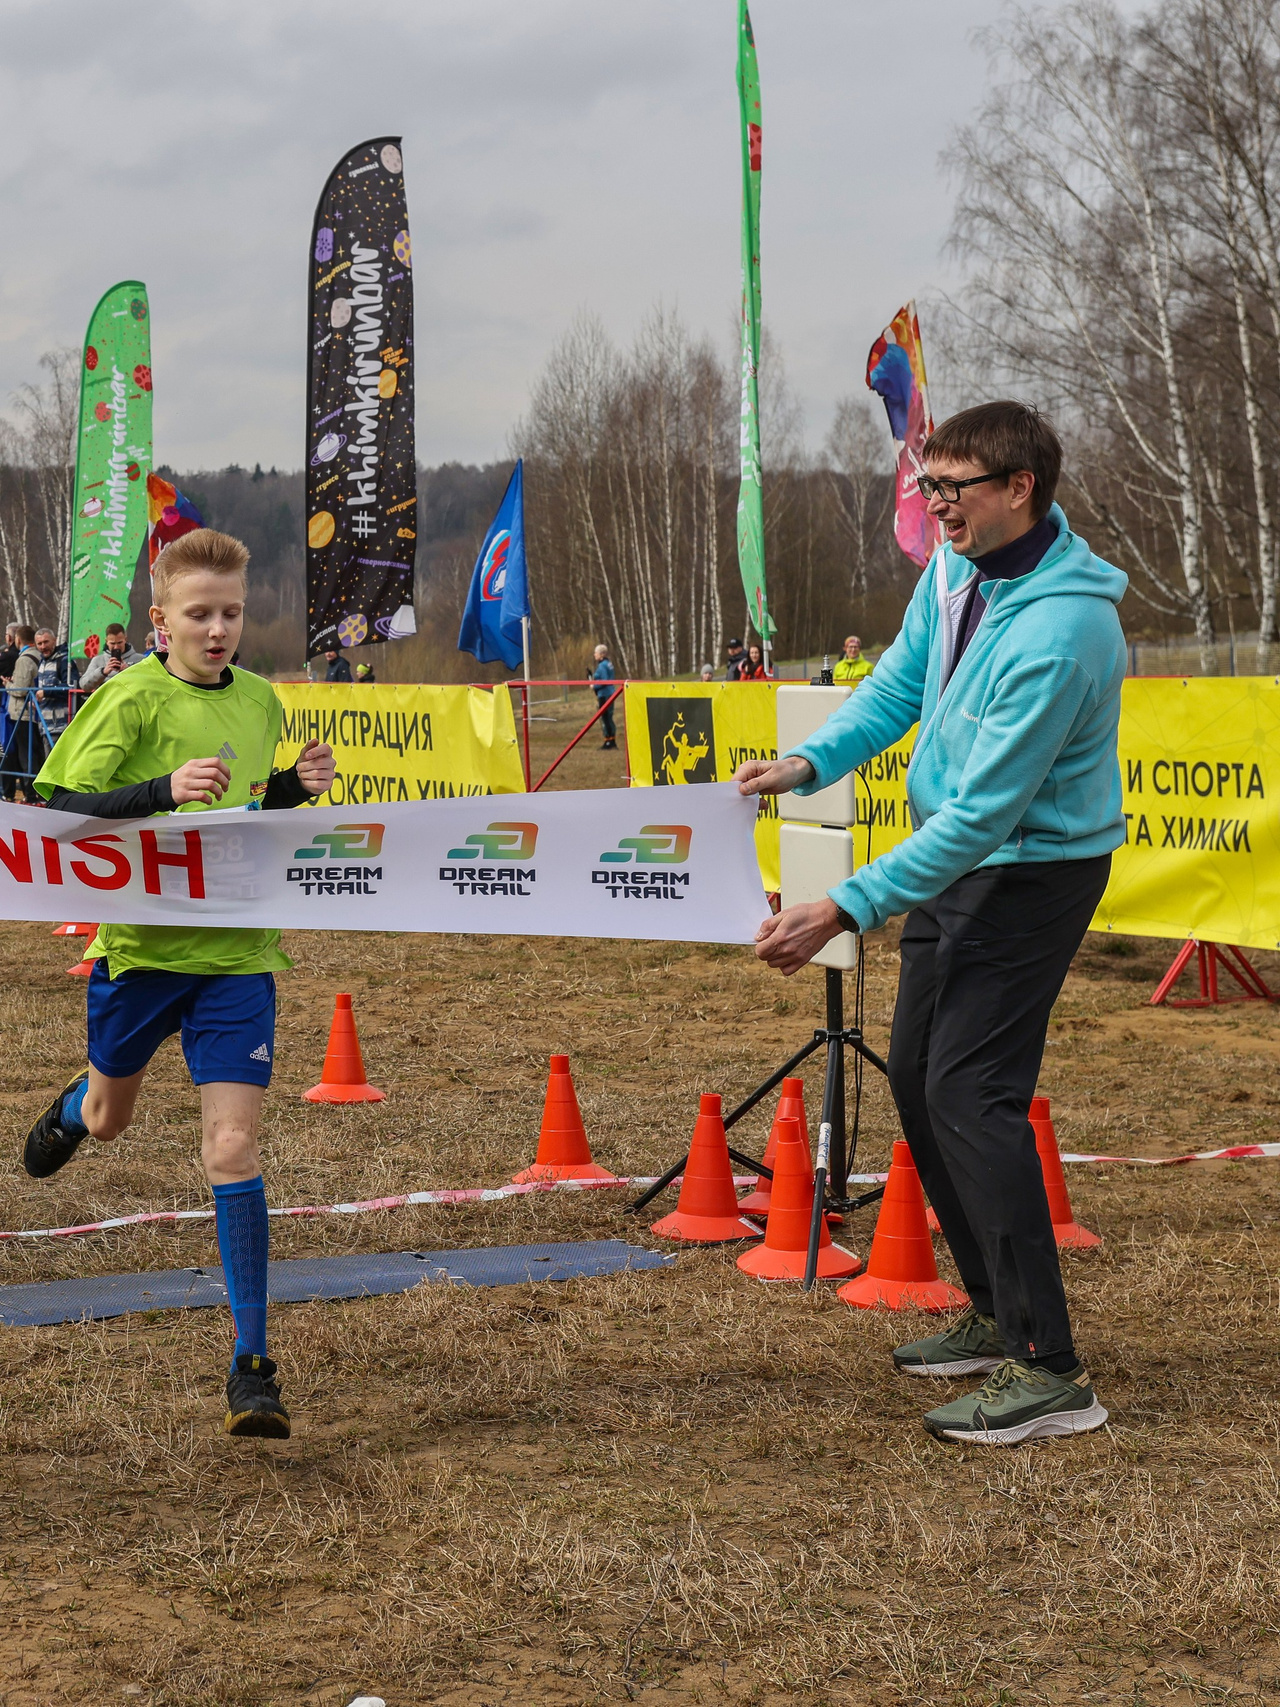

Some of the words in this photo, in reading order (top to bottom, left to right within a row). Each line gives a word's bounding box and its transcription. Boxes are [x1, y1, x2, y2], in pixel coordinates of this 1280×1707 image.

[343, 240, 384, 539] #khimkirunbar
[99, 364, 129, 581] #khimkirunbar
[280, 708, 433, 757] МИНИСТРАЦИЯ
[1126, 759, 1143, 793] И
[1152, 760, 1265, 799] СПОРТА
[1161, 815, 1251, 853] ХИМКИ
[287, 867, 382, 881] DREAM
[440, 868, 535, 881] DREAM
[592, 871, 689, 885] DREAM
[299, 882, 377, 895] TRAIL
[453, 883, 531, 895] TRAIL
[606, 886, 685, 899] TRAIL
